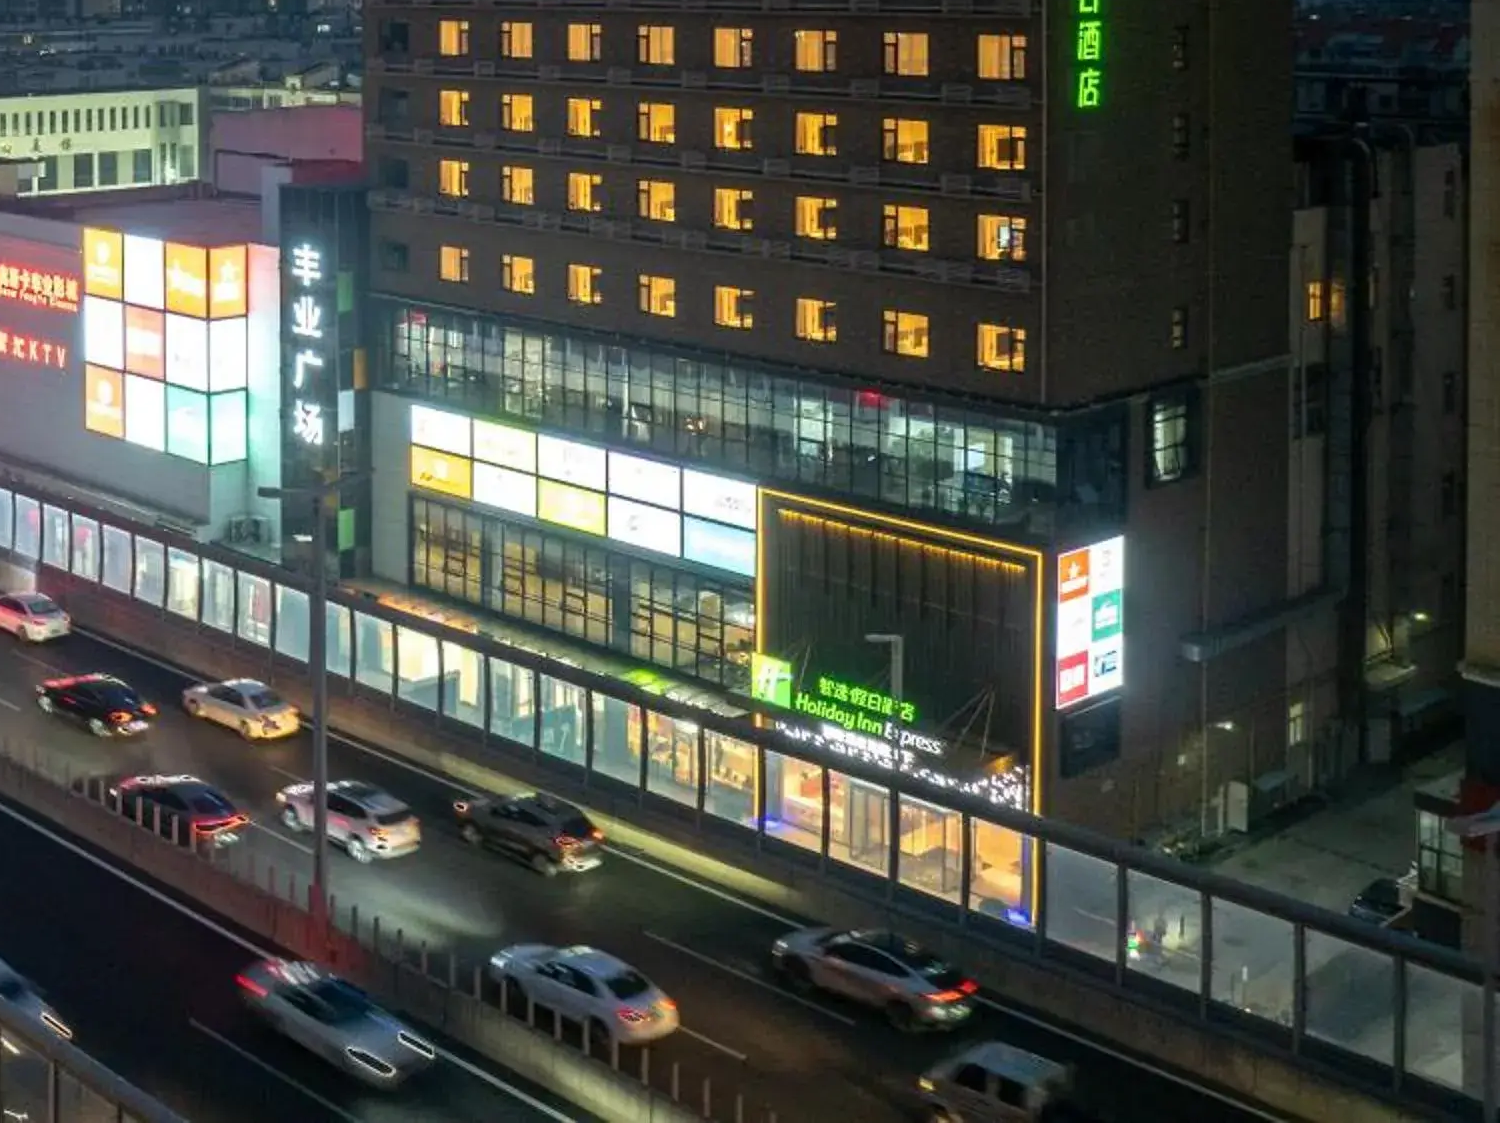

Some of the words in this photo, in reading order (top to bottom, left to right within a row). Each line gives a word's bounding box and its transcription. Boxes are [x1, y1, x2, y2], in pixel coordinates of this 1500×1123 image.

[292, 244, 323, 445] 丰业广场
[796, 692, 855, 730] Holiday
[856, 711, 883, 735] Inn
[819, 677, 915, 722] 智选假日酒店
